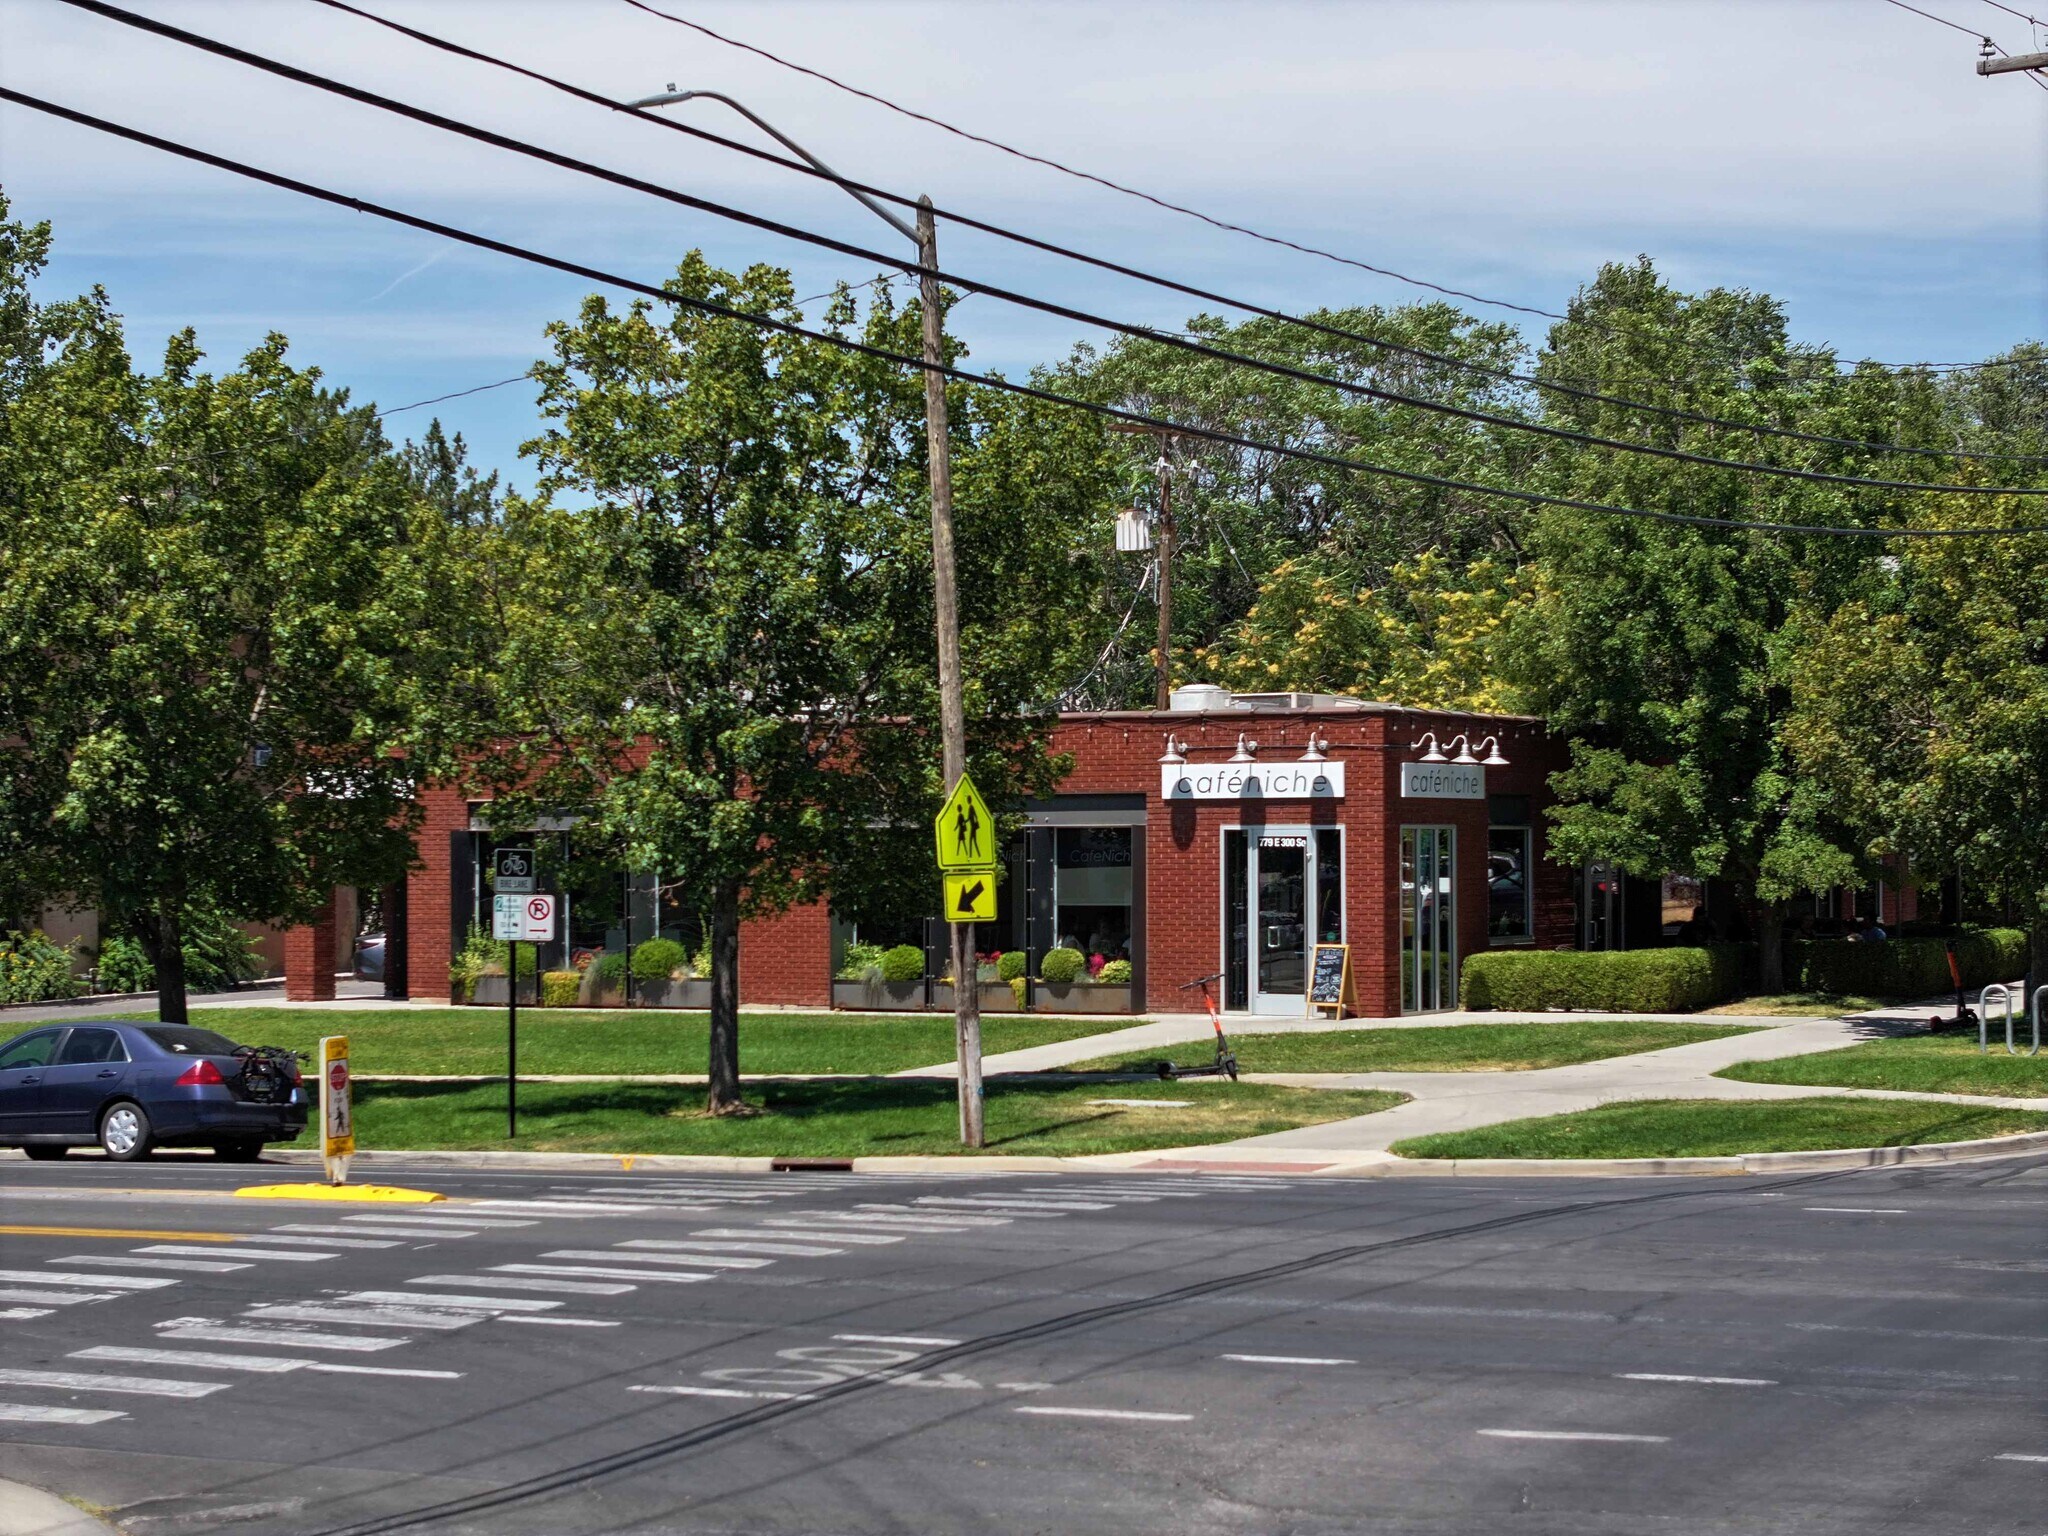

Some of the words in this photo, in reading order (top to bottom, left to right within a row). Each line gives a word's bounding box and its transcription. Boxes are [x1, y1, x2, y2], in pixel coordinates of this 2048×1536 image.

[1178, 770, 1327, 794] caféniche
[1411, 769, 1478, 794] caféniche
[1260, 838, 1273, 847] 779
[1274, 838, 1280, 847] E
[1281, 838, 1295, 847] 300
